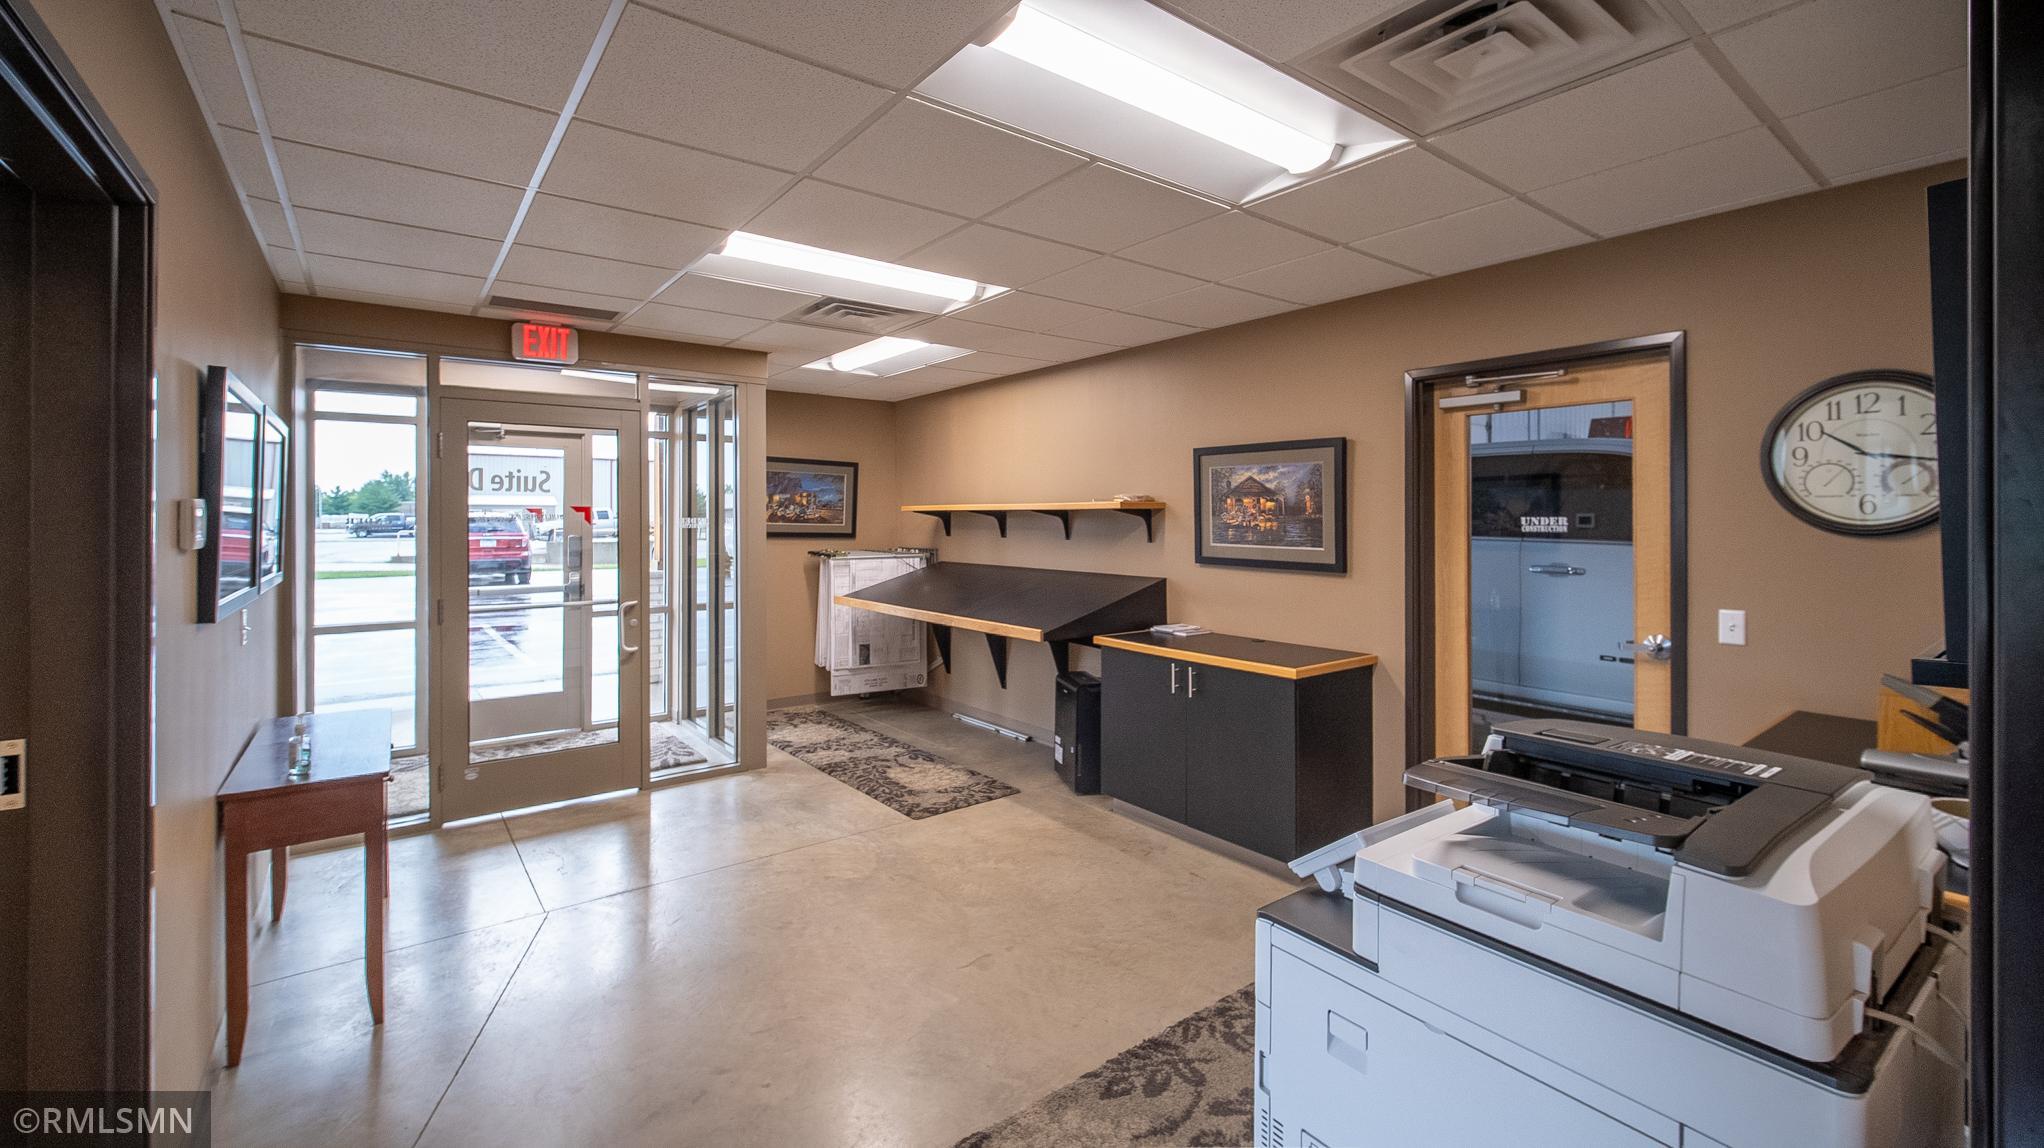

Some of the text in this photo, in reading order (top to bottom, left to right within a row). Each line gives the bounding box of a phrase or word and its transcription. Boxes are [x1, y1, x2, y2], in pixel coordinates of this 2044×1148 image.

[523, 324, 570, 360] EXIT
[1826, 401, 1842, 421] 11
[1854, 392, 1881, 414] 12
[1897, 395, 1907, 416] 1
[1797, 421, 1825, 442] 10
[1920, 413, 1937, 436] 2
[1792, 447, 1809, 467] 9
[1859, 494, 1877, 515] 6
[1520, 516, 1568, 526] UNDER
